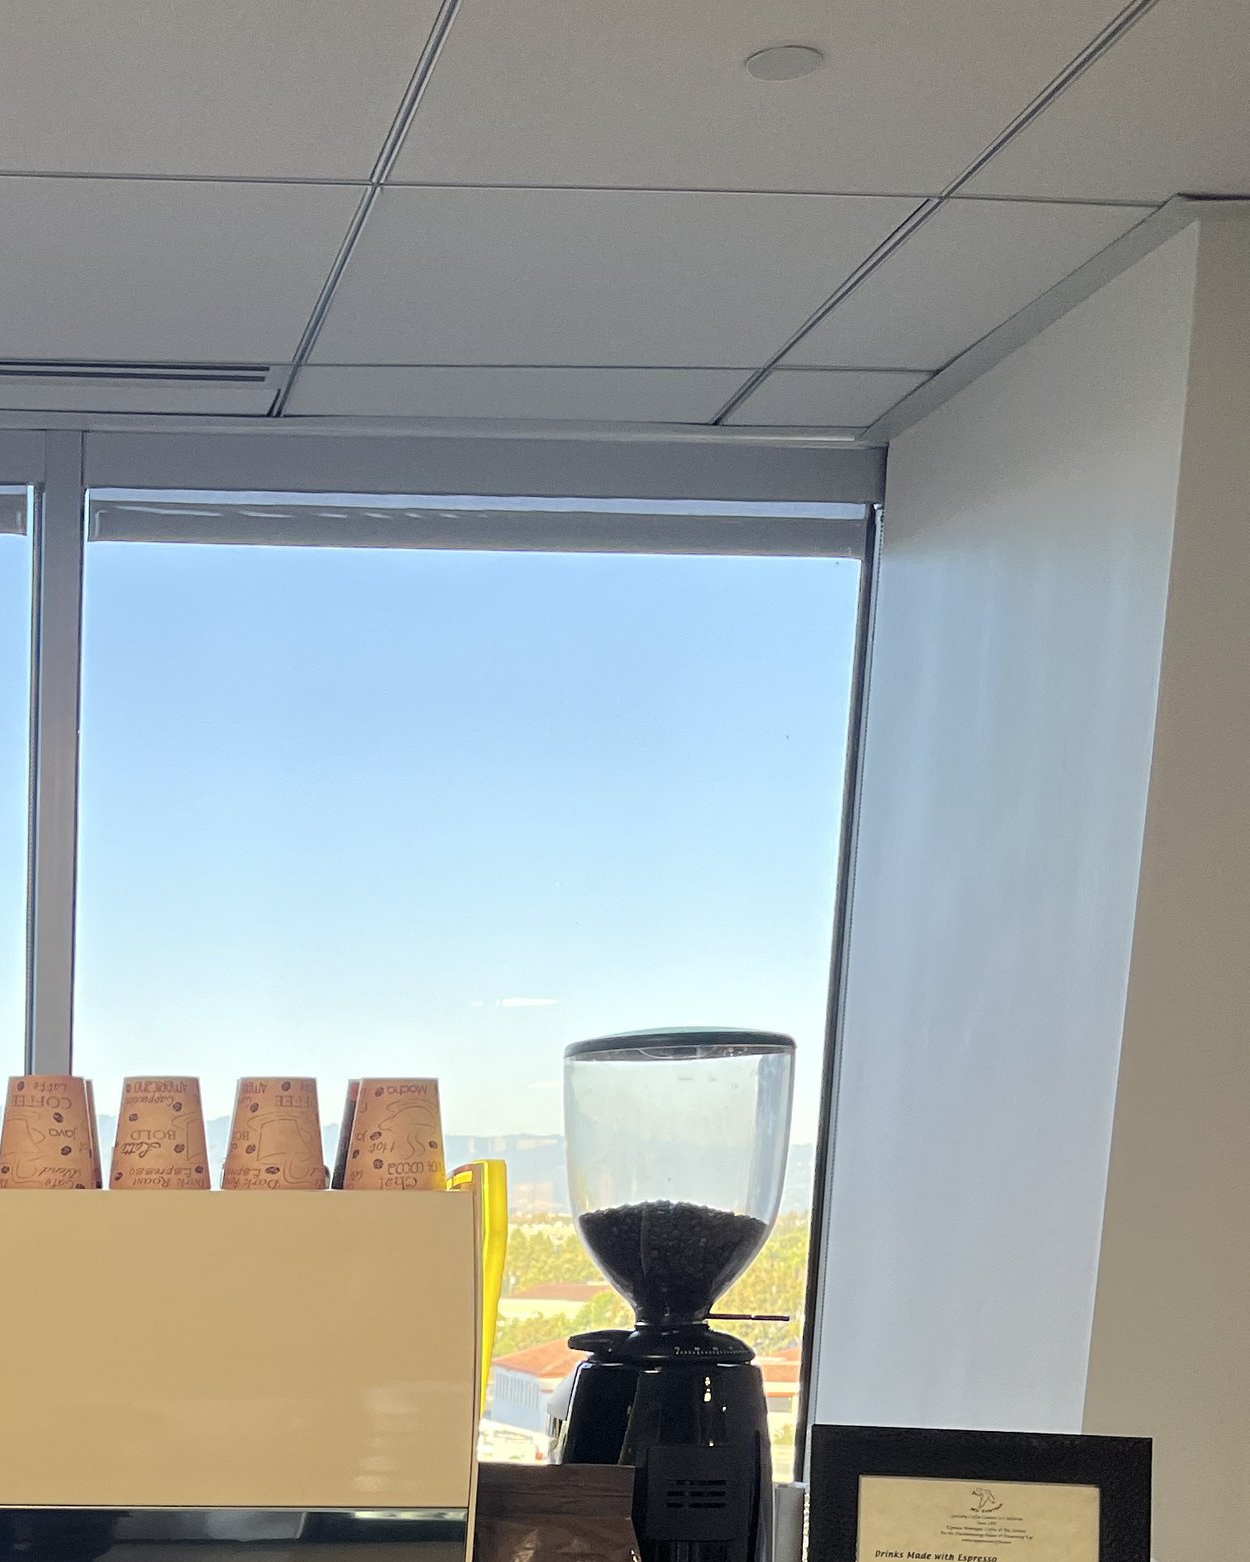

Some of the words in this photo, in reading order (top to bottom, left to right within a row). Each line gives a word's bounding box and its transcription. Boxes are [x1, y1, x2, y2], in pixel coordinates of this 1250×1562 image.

[387, 1084, 427, 1097] Mocha
[49, 1128, 77, 1140] java
[131, 1130, 176, 1140] BOLD
[369, 1141, 395, 1154] Hot
[875, 1550, 903, 1559] Drinks
[907, 1552, 931, 1560] Made
[934, 1553, 955, 1561] with
[958, 1554, 998, 1562] Espresso
